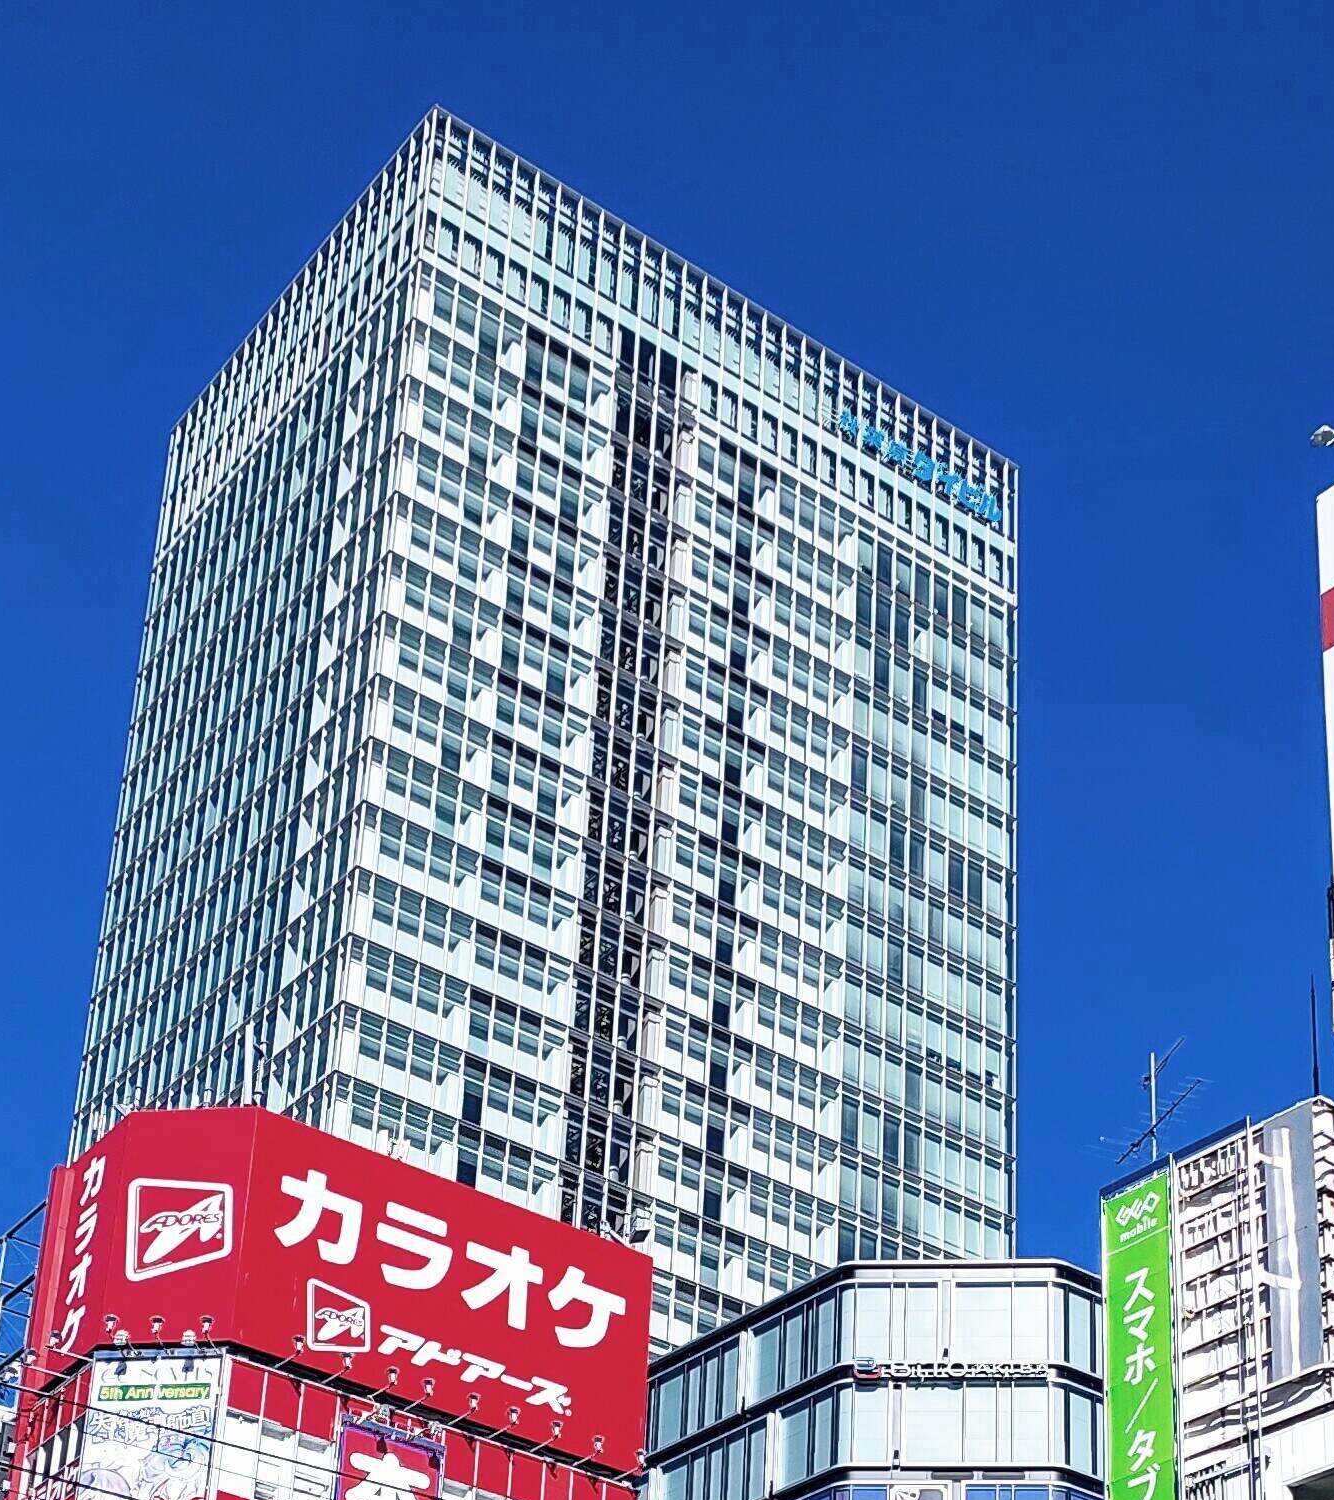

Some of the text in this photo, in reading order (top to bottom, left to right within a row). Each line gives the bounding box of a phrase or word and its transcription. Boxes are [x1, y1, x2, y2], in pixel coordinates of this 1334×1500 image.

[146, 1211, 223, 1232] ADORES
[1119, 1217, 1158, 1243] mobile
[61, 1154, 108, 1355] カラオケ
[275, 1168, 627, 1349] カラオケ
[100, 1385, 209, 1400] 5th Annversary
[378, 1324, 571, 1414] アドアーズ
